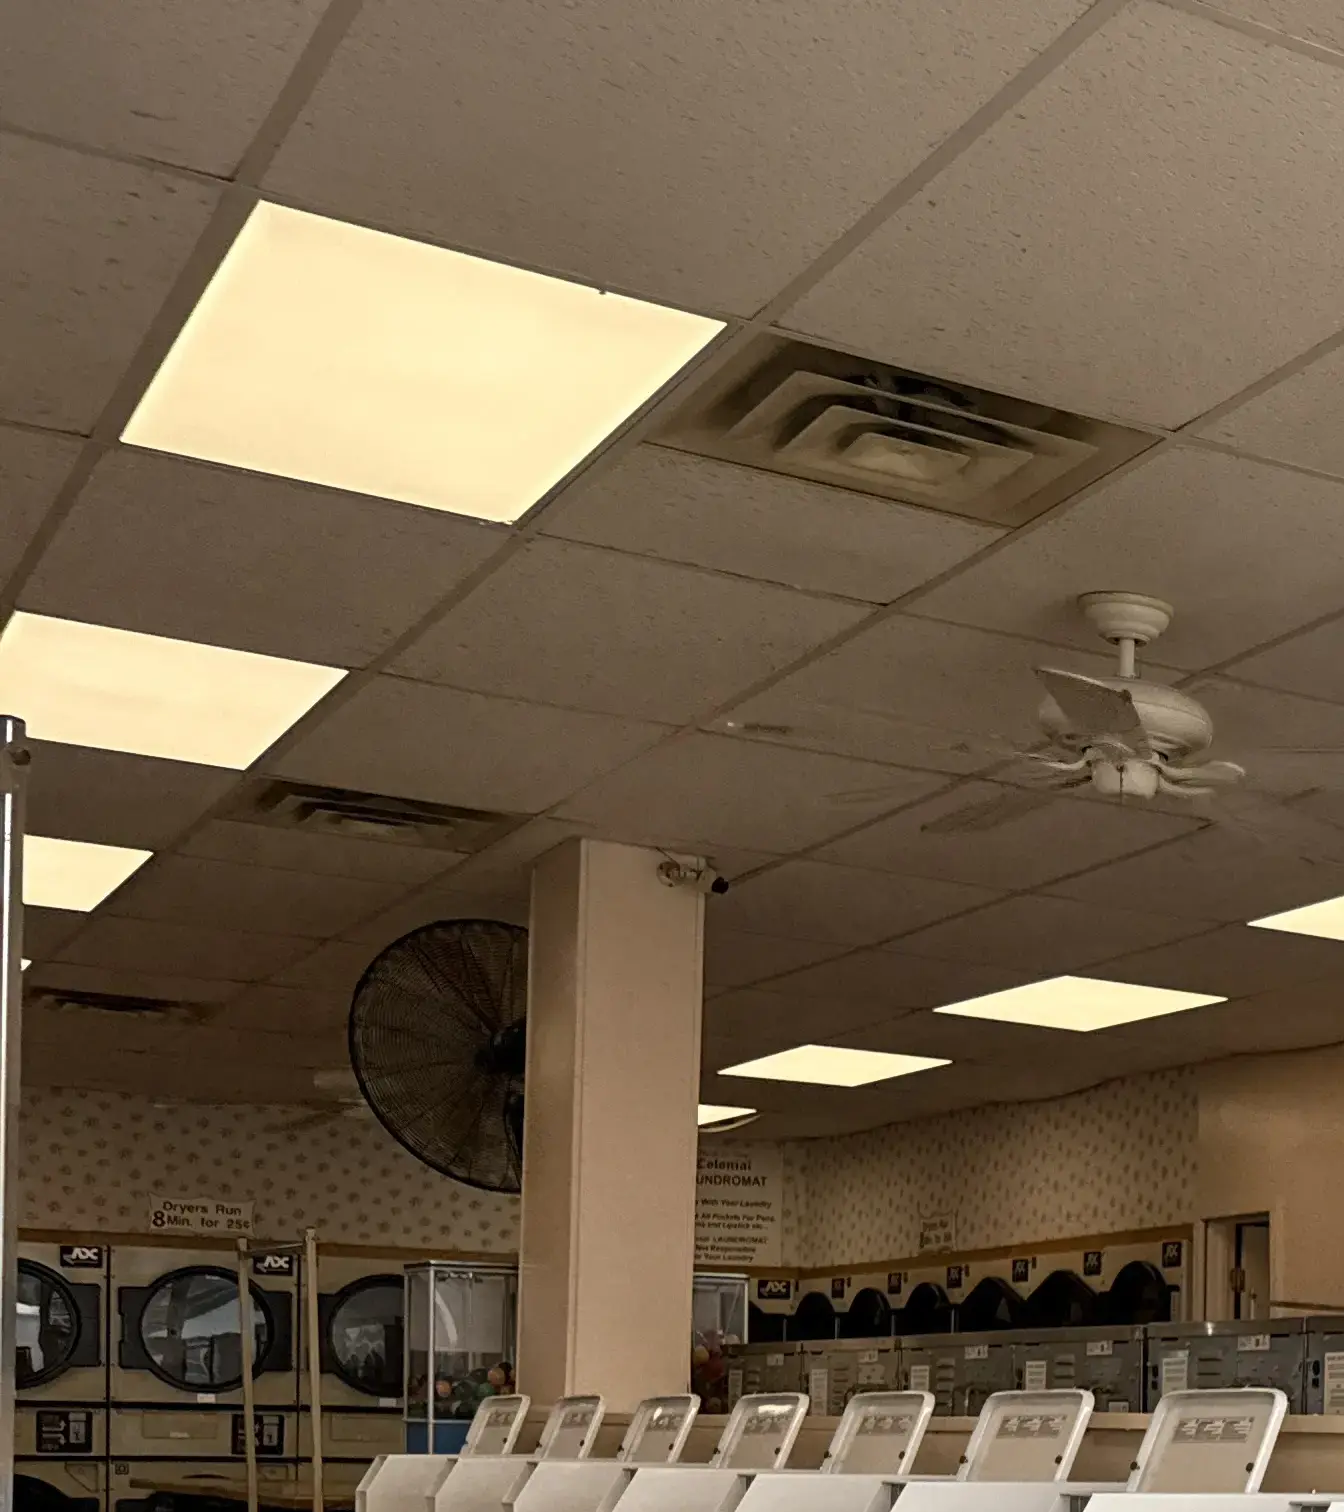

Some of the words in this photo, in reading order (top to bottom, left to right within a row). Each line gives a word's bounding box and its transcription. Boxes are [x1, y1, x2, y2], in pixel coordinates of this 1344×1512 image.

[162, 1201, 208, 1214] Dryers
[216, 1204, 242, 1216] Run
[152, 1210, 166, 1228] 8
[200, 1217, 219, 1228] for
